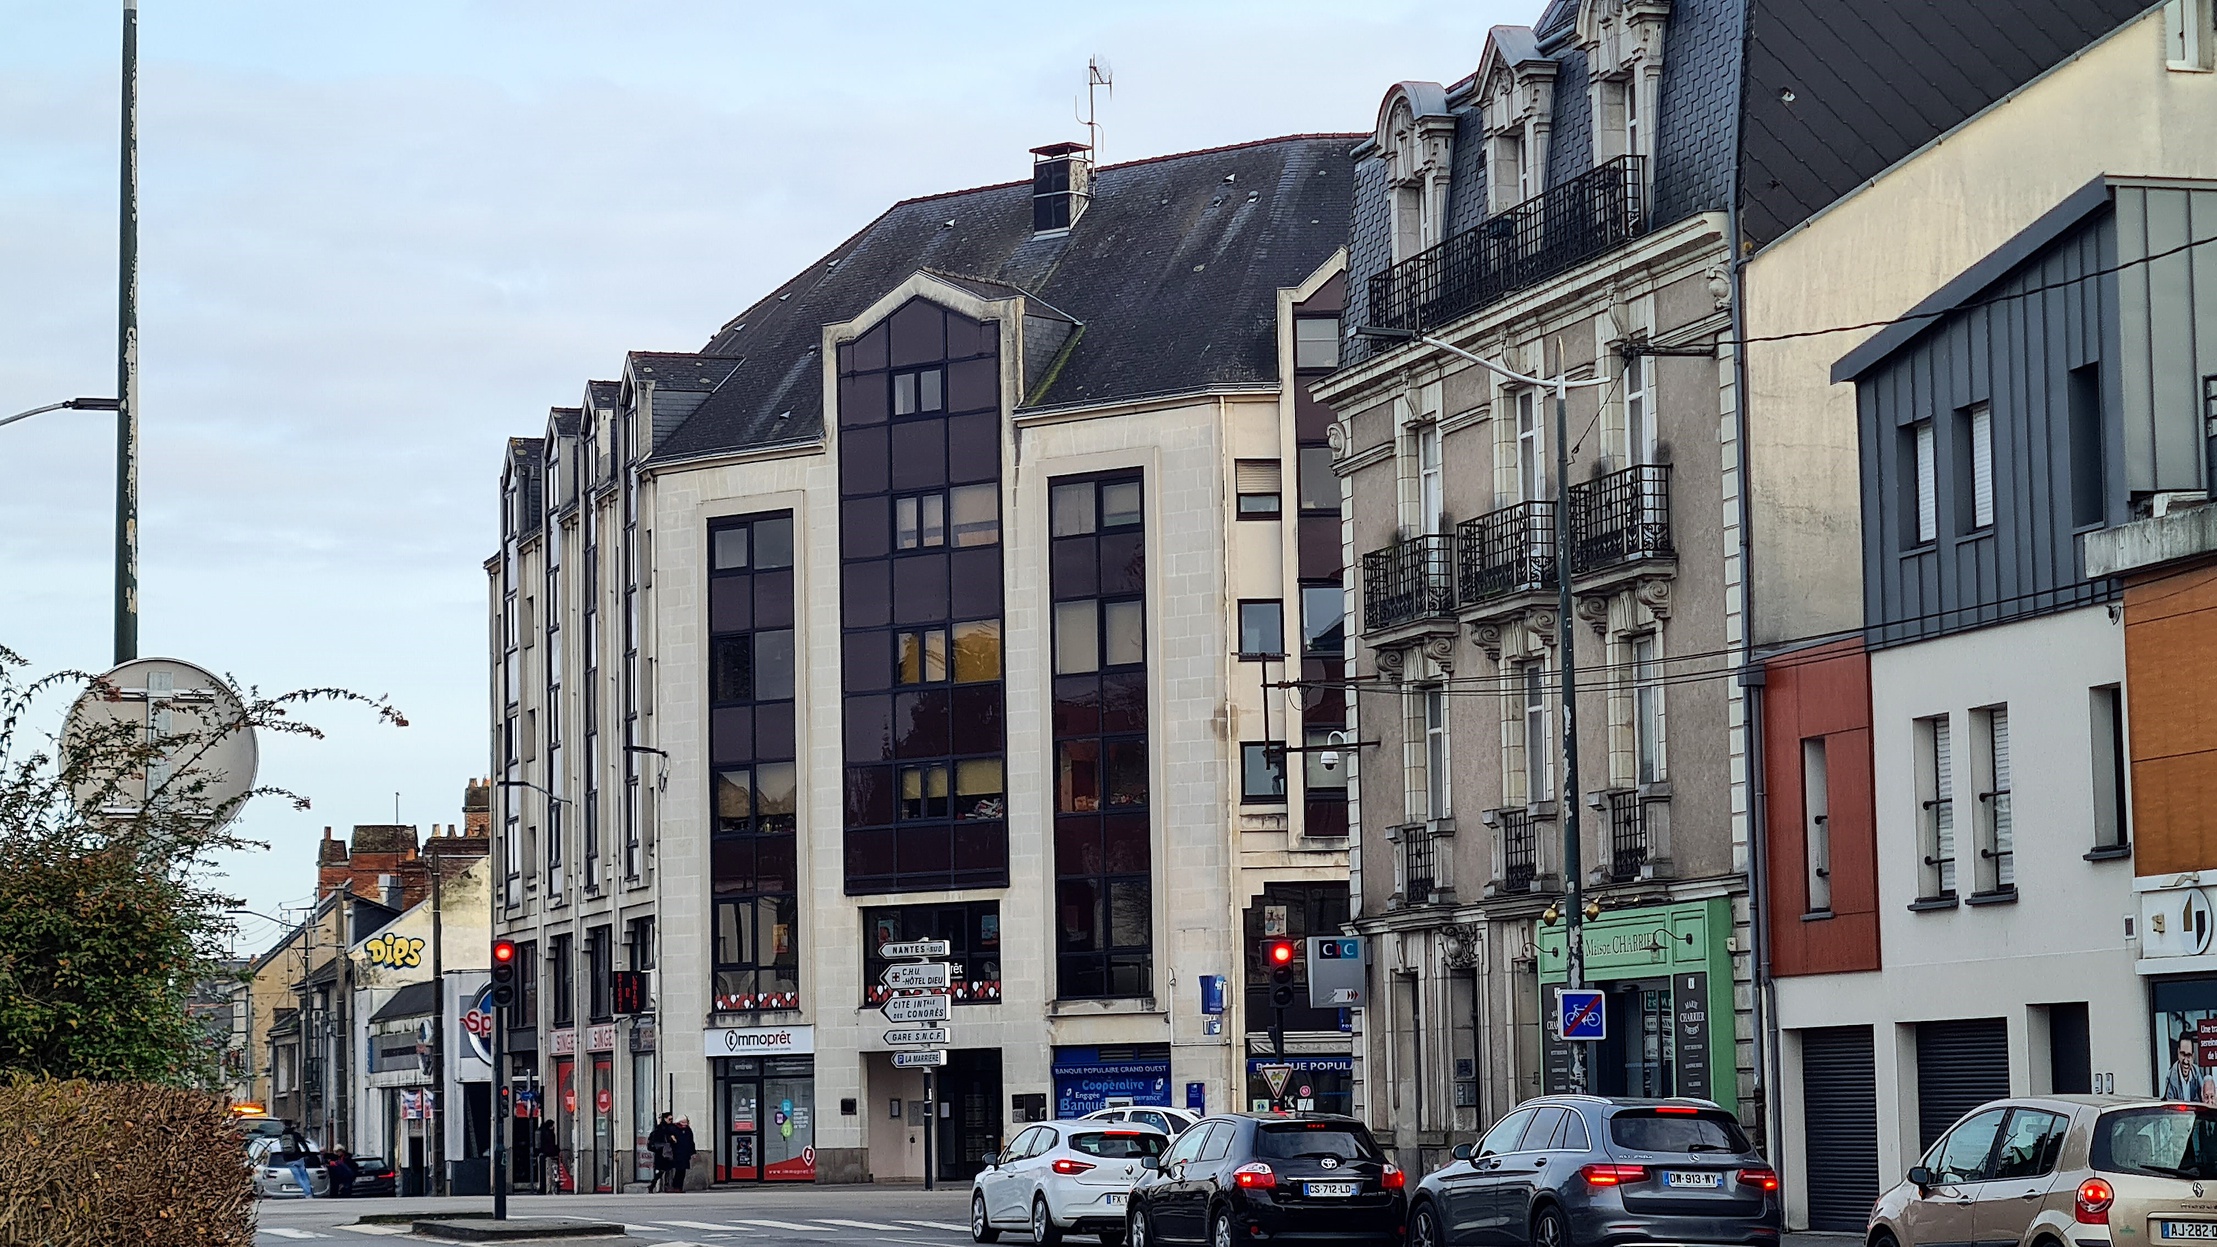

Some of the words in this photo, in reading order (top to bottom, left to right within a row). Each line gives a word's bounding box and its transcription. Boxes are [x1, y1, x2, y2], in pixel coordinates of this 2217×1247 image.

[927, 976, 943, 985] DIEU
[1679, 1011, 1705, 1022] CHARRIER
[892, 1033, 912, 1041] GARE
[915, 1032, 943, 1041] S.N.C.F.
[905, 1055, 912, 1063] LA
[1083, 1066, 1119, 1074] POPULAIRE
[1120, 1065, 1144, 1073] GRAND
[1082, 1079, 1145, 1092] Coopérative
[1060, 1098, 1106, 1112] Banque
[1309, 1184, 1352, 1194] CS-712-LD
